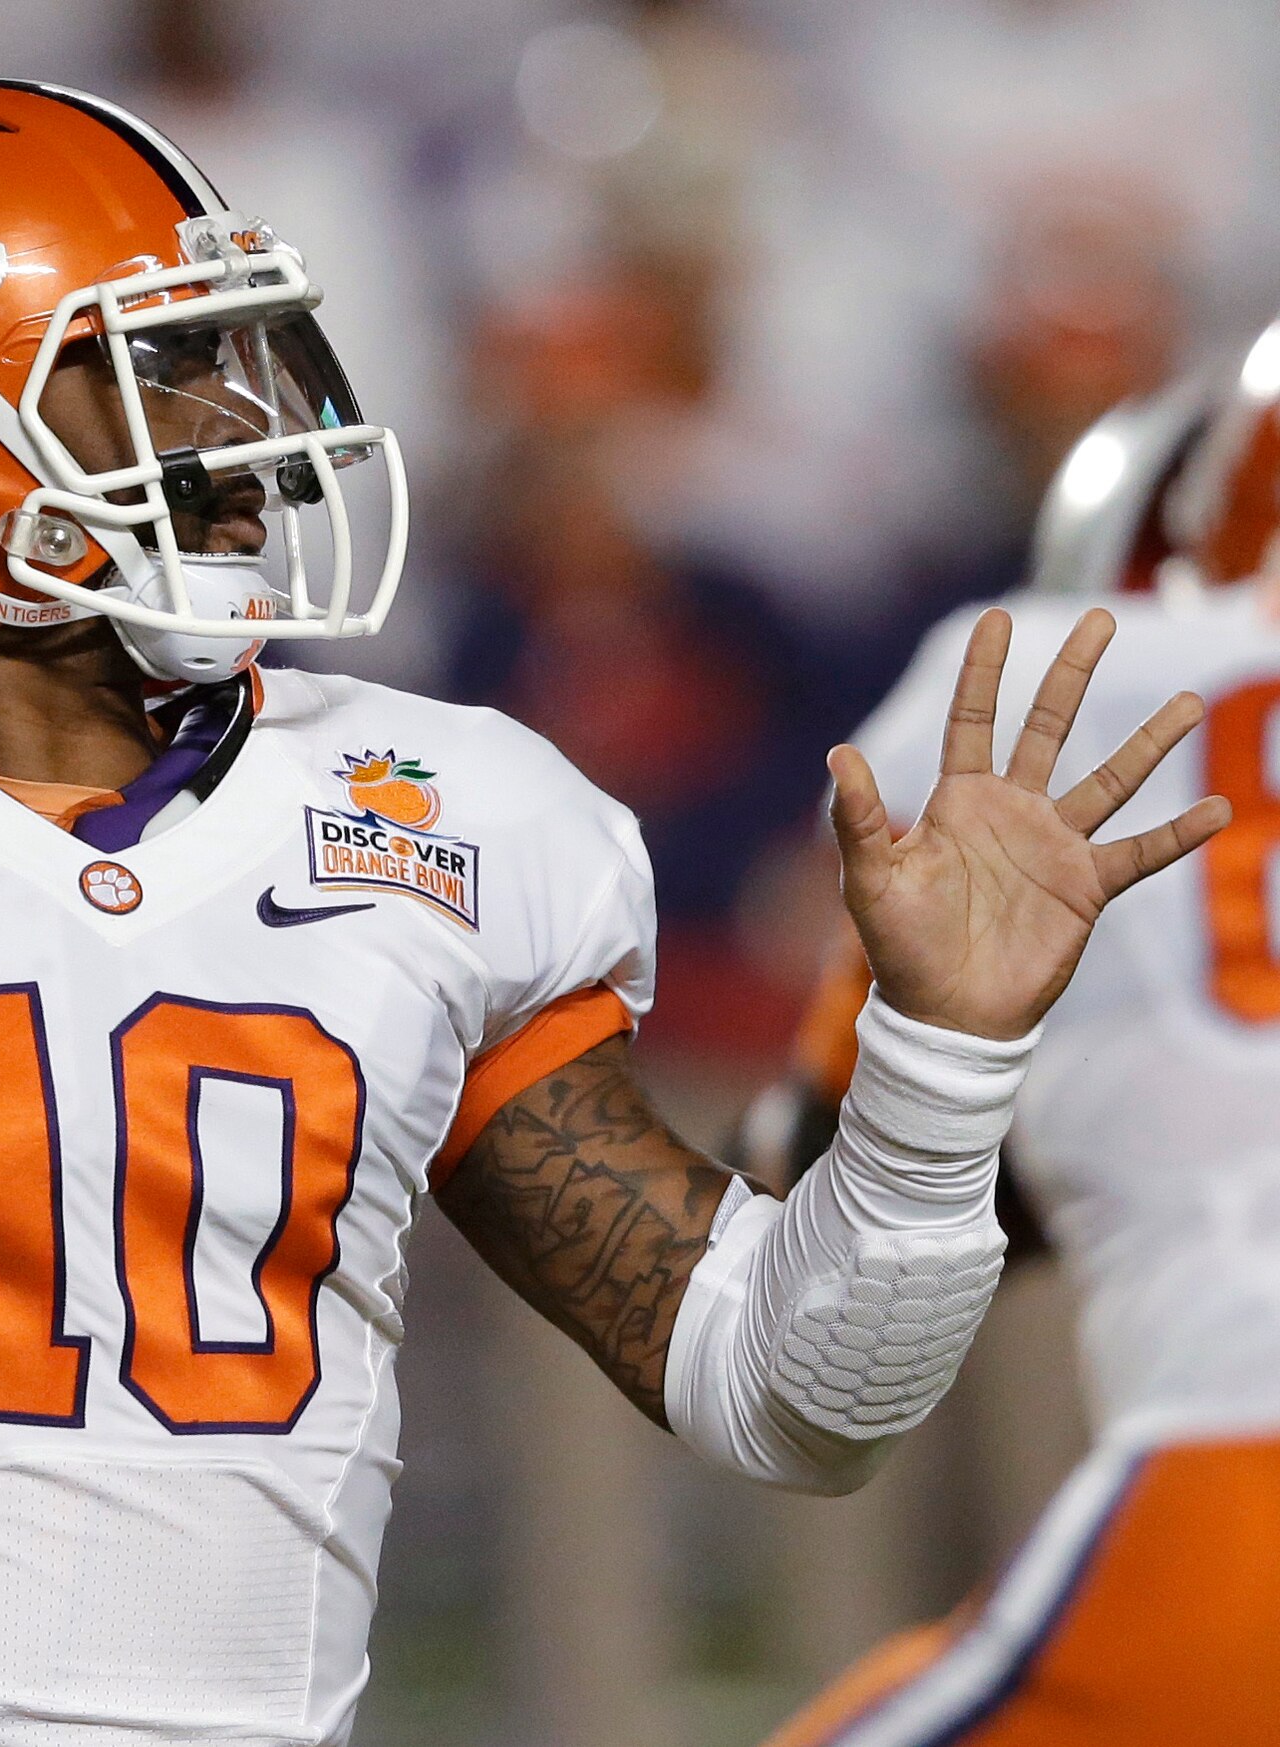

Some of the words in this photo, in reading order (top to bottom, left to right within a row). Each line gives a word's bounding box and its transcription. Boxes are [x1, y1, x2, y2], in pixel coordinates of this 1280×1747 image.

[13, 605, 71, 623] TIGERS
[321, 821, 466, 877] DISCOVER
[322, 844, 410, 882] ORANGE
[414, 861, 471, 914] BOWL
